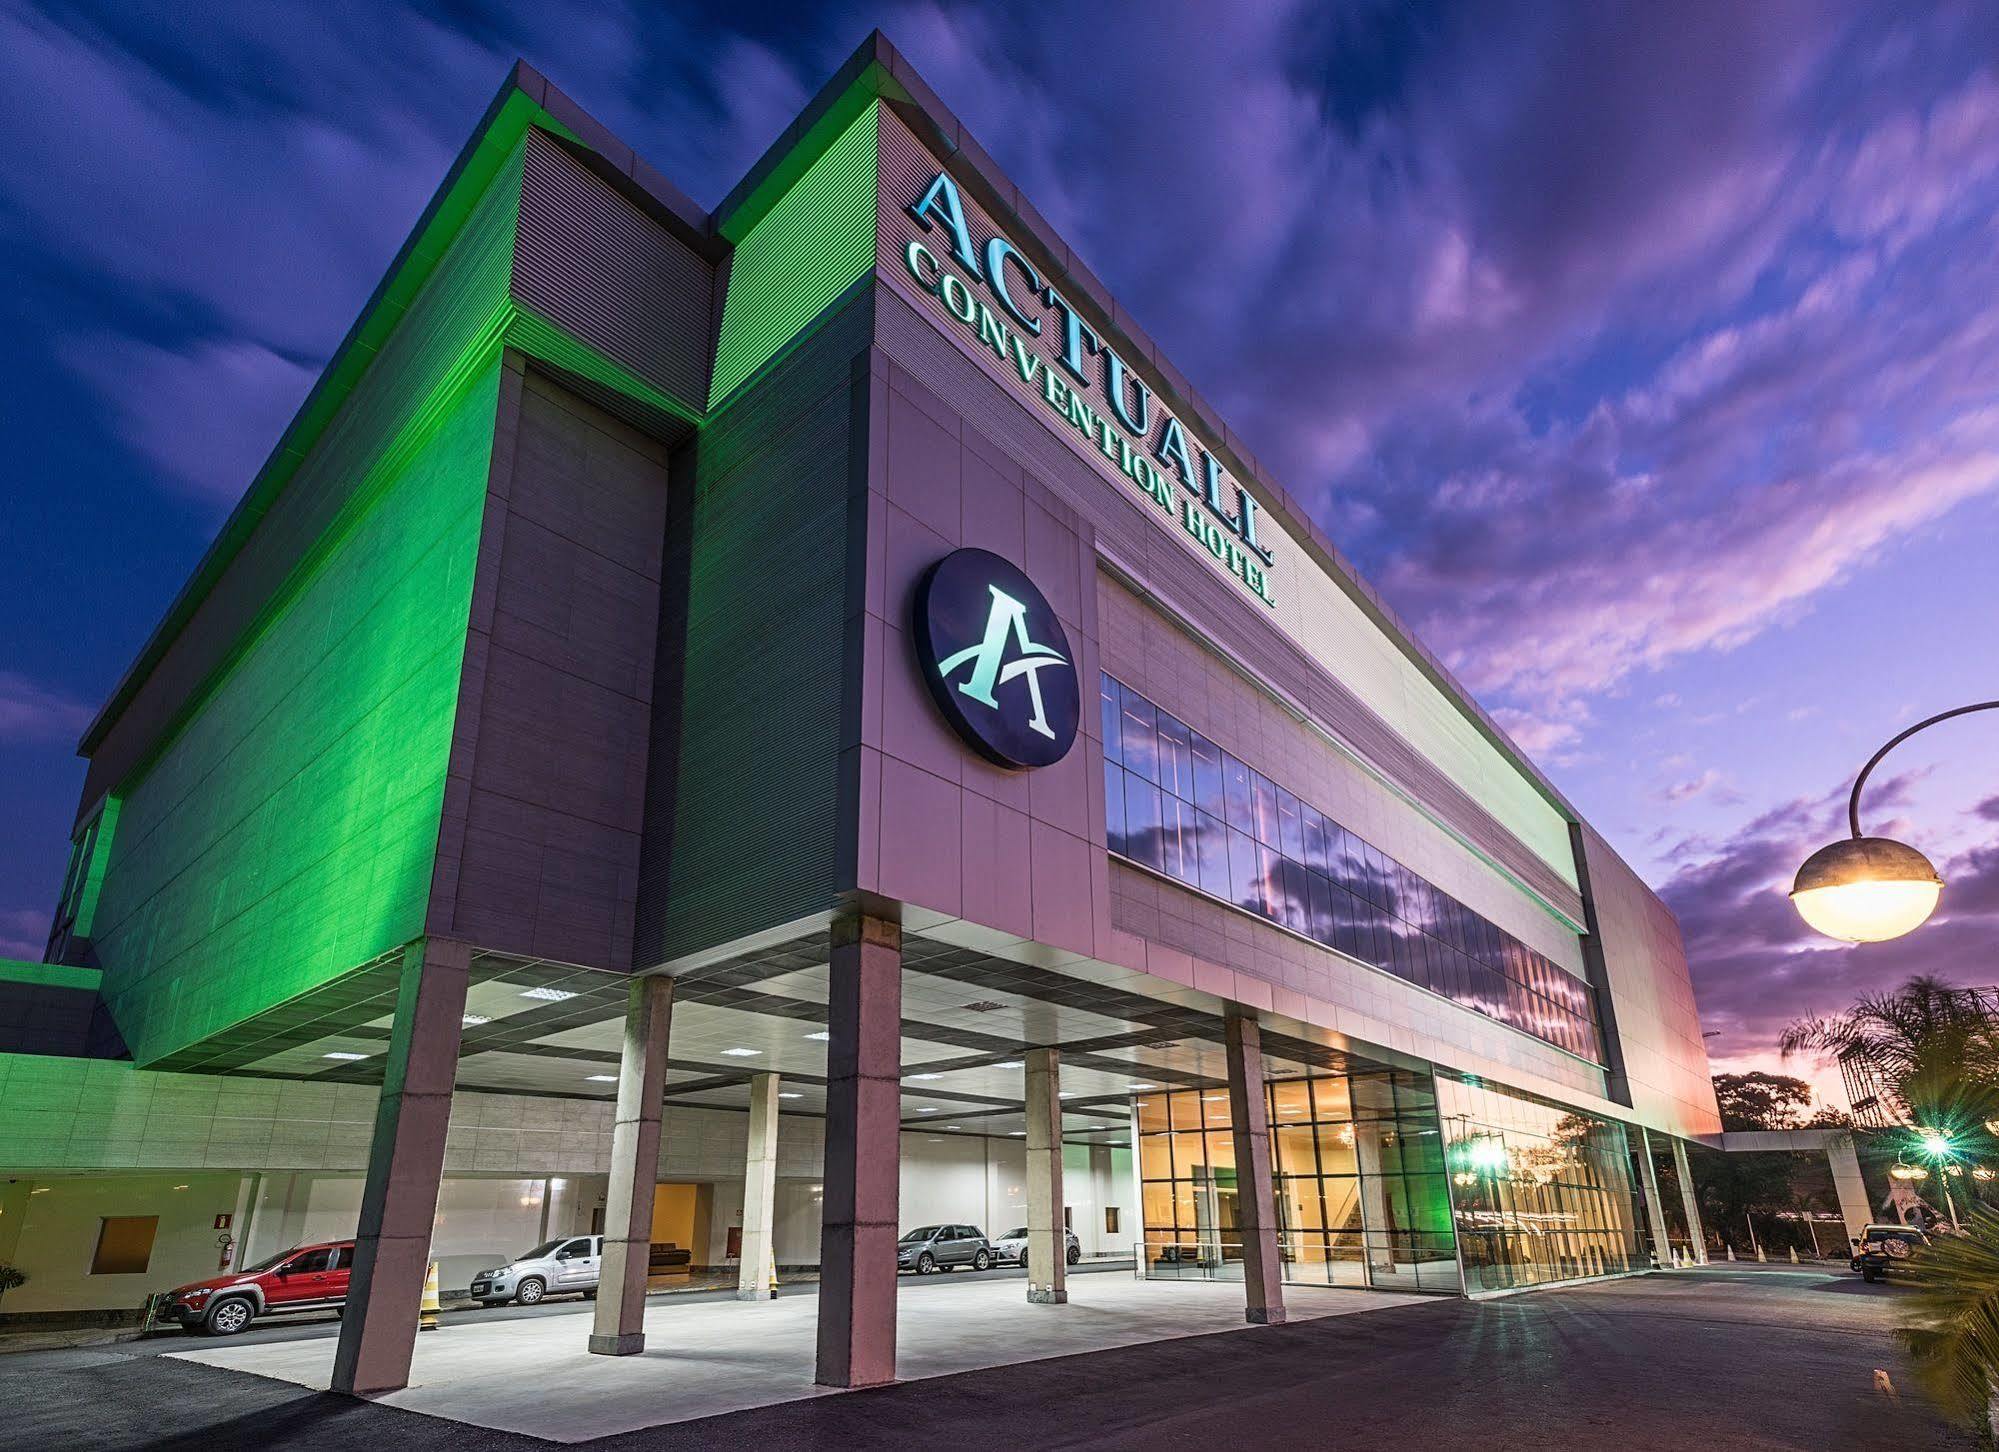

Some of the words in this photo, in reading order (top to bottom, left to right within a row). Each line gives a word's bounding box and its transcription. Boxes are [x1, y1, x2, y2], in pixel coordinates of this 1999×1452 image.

[904, 240, 1175, 516] CONVENTION
[1182, 500, 1277, 609] HOTEL
[908, 171, 1275, 568] ACTUALL
